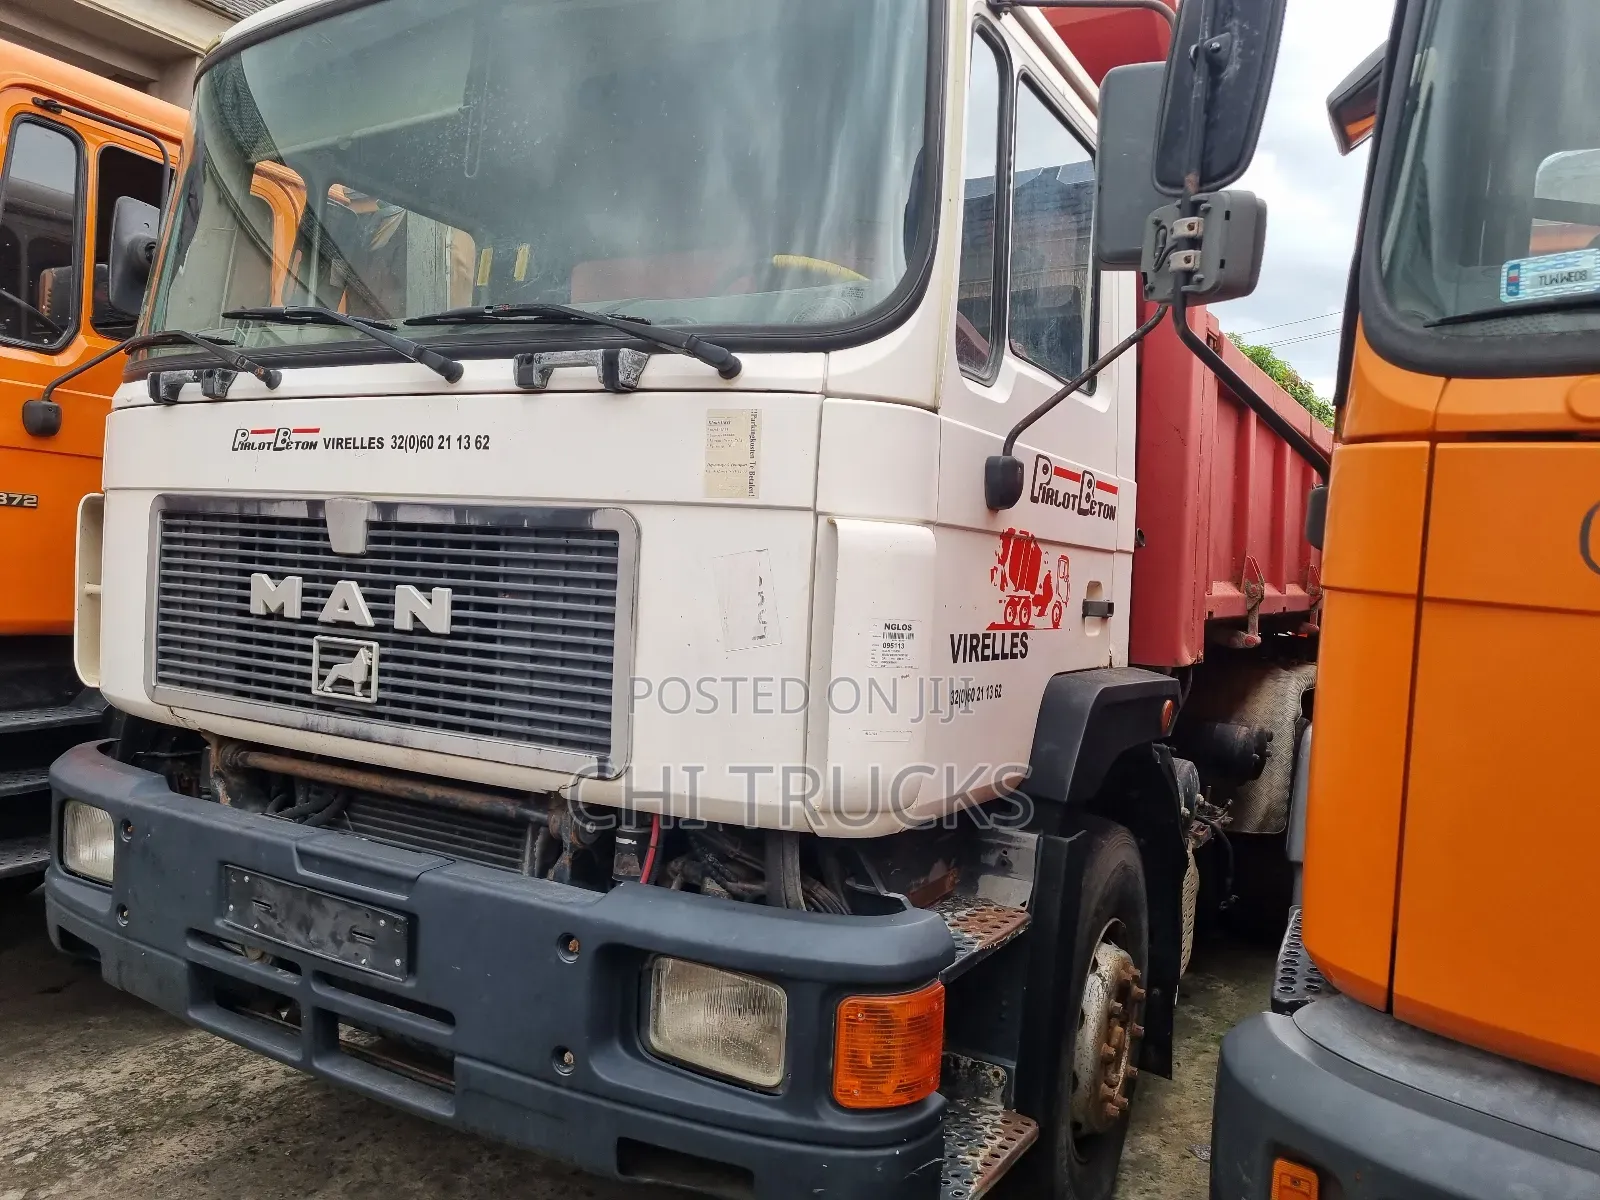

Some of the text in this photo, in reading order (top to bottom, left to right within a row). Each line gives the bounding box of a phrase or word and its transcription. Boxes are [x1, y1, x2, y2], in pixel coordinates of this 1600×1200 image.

[323, 436, 385, 450] VIRELLES
[390, 434, 434, 453] 32(0)60
[437, 434, 452, 450] 21
[456, 434, 471, 450] 13
[474, 434, 490, 450] 62
[250, 572, 453, 635] MAN
[949, 631, 1029, 664] VIRELLES
[976, 685, 985, 702] 21
[985, 684, 994, 700] 13
[994, 683, 1003, 699] 62
